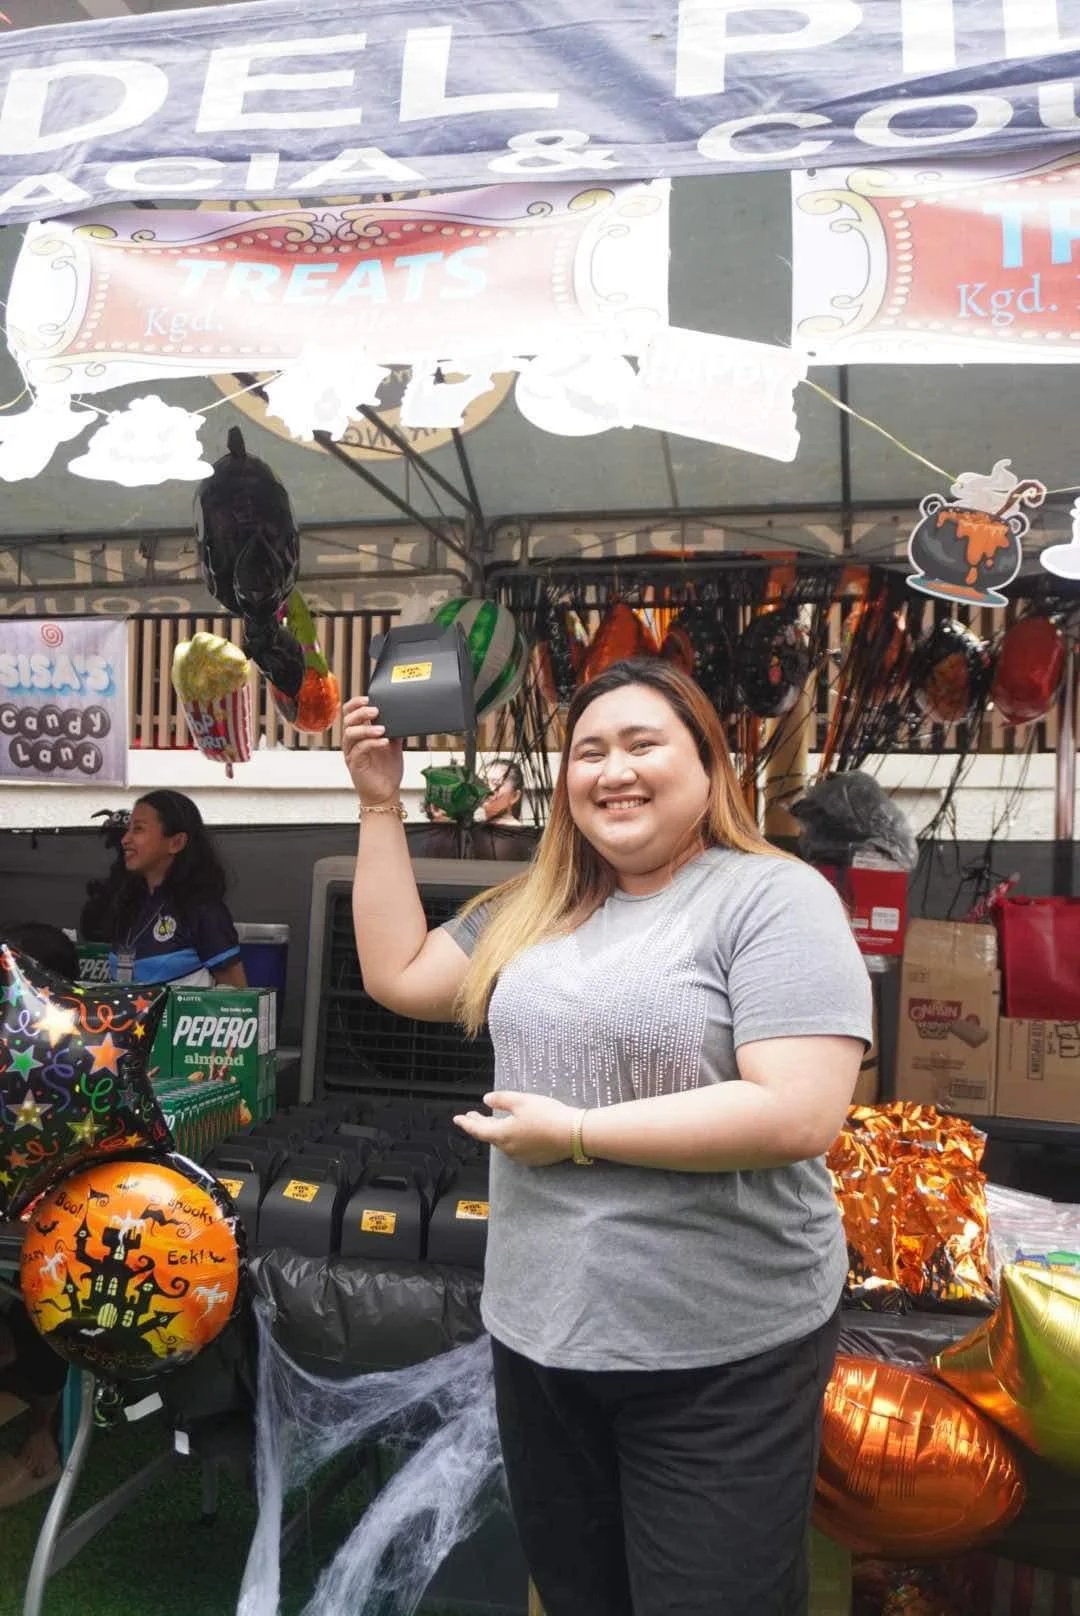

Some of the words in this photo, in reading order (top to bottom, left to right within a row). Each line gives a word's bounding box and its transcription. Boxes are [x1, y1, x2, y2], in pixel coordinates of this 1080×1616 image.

[487, 129, 618, 172] &
[173, 246, 489, 305] TREATS
[958, 271, 1058, 326] Kgd.
[143, 305, 223, 343] Kgd.
[17, 743, 96, 768] Land
[172, 1015, 258, 1049] PEPERO
[183, 1052, 245, 1067] almond
[167, 1250, 204, 1266] Eek!
